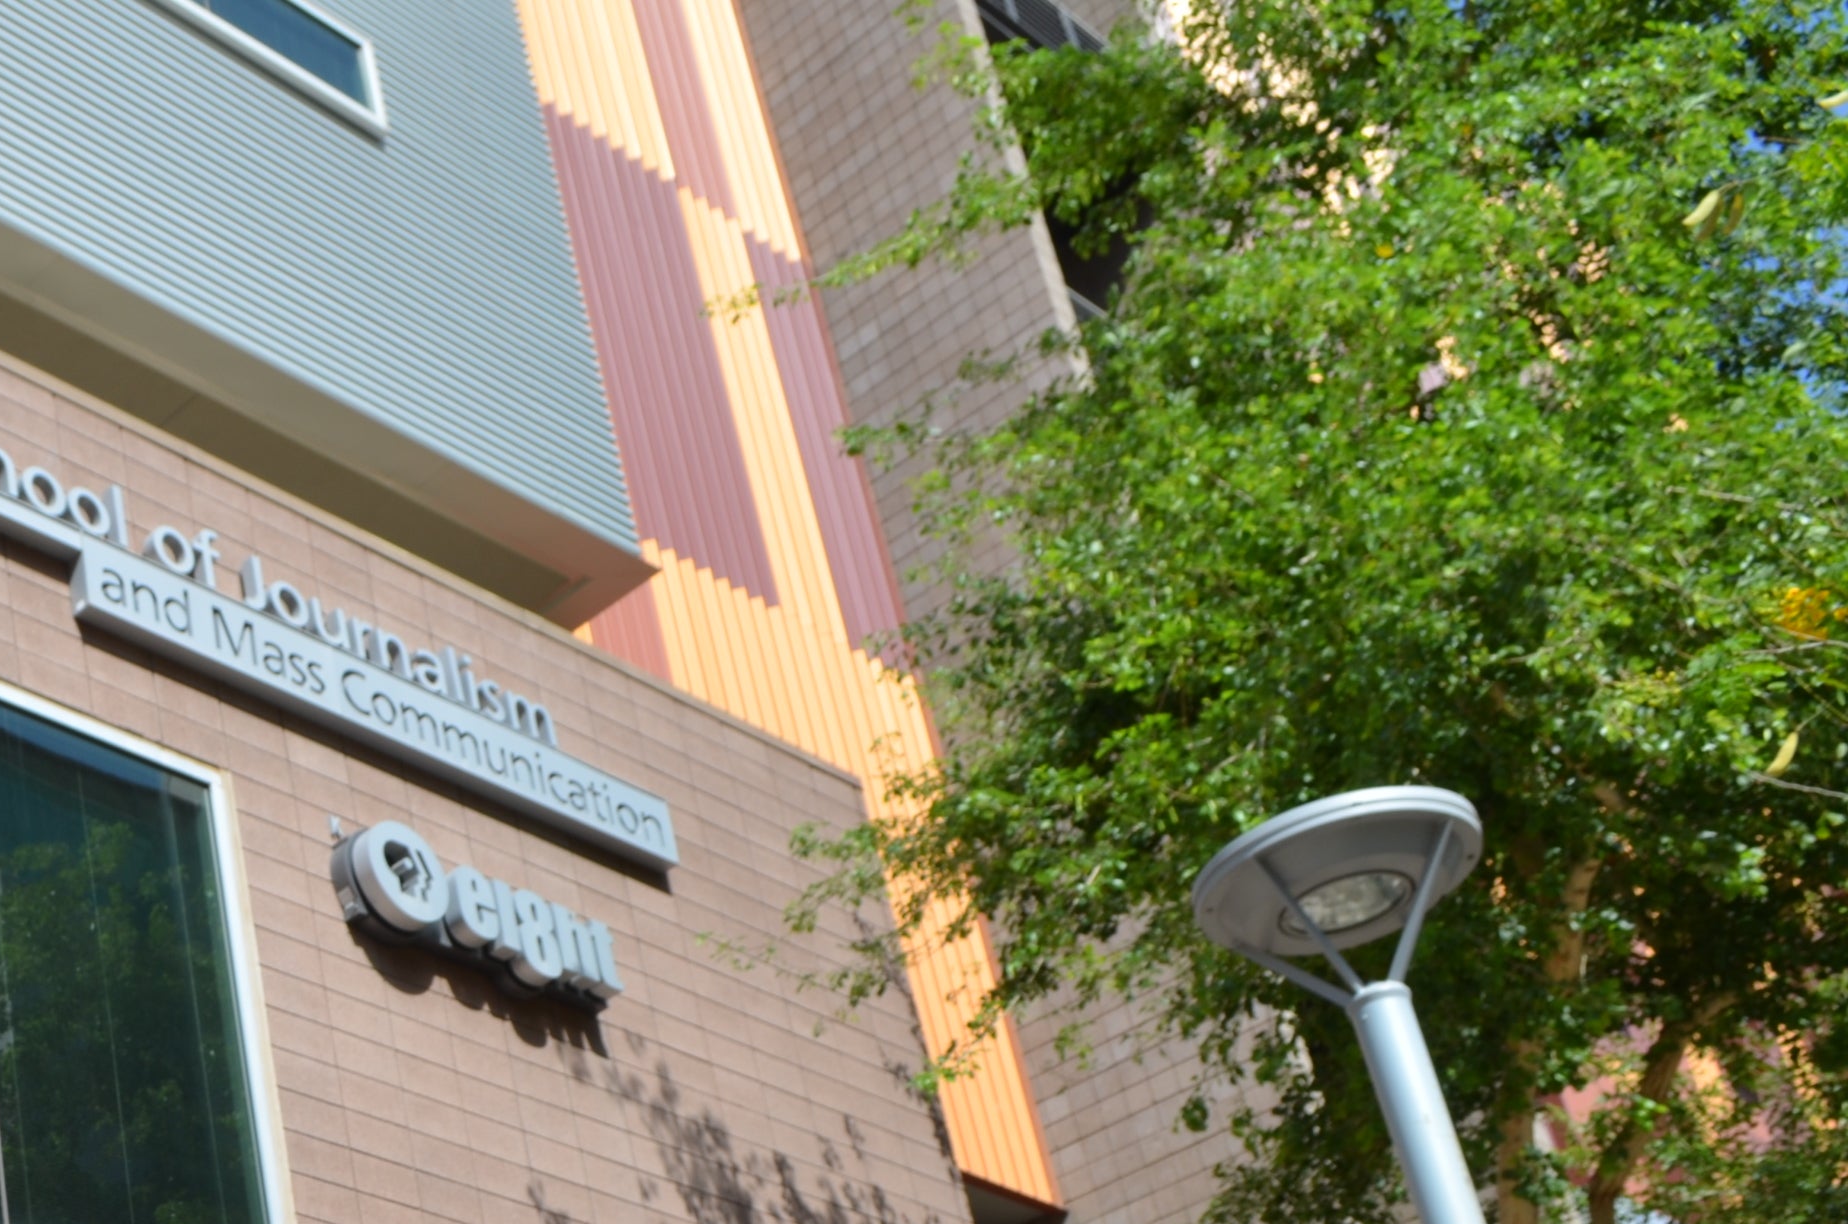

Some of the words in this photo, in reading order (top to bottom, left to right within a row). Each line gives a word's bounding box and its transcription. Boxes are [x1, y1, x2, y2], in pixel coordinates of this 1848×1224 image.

[101, 568, 193, 636] and
[212, 605, 326, 695] Mass
[341, 668, 666, 848] Communication
[142, 525, 220, 588] of
[240, 555, 557, 748] Journalism
